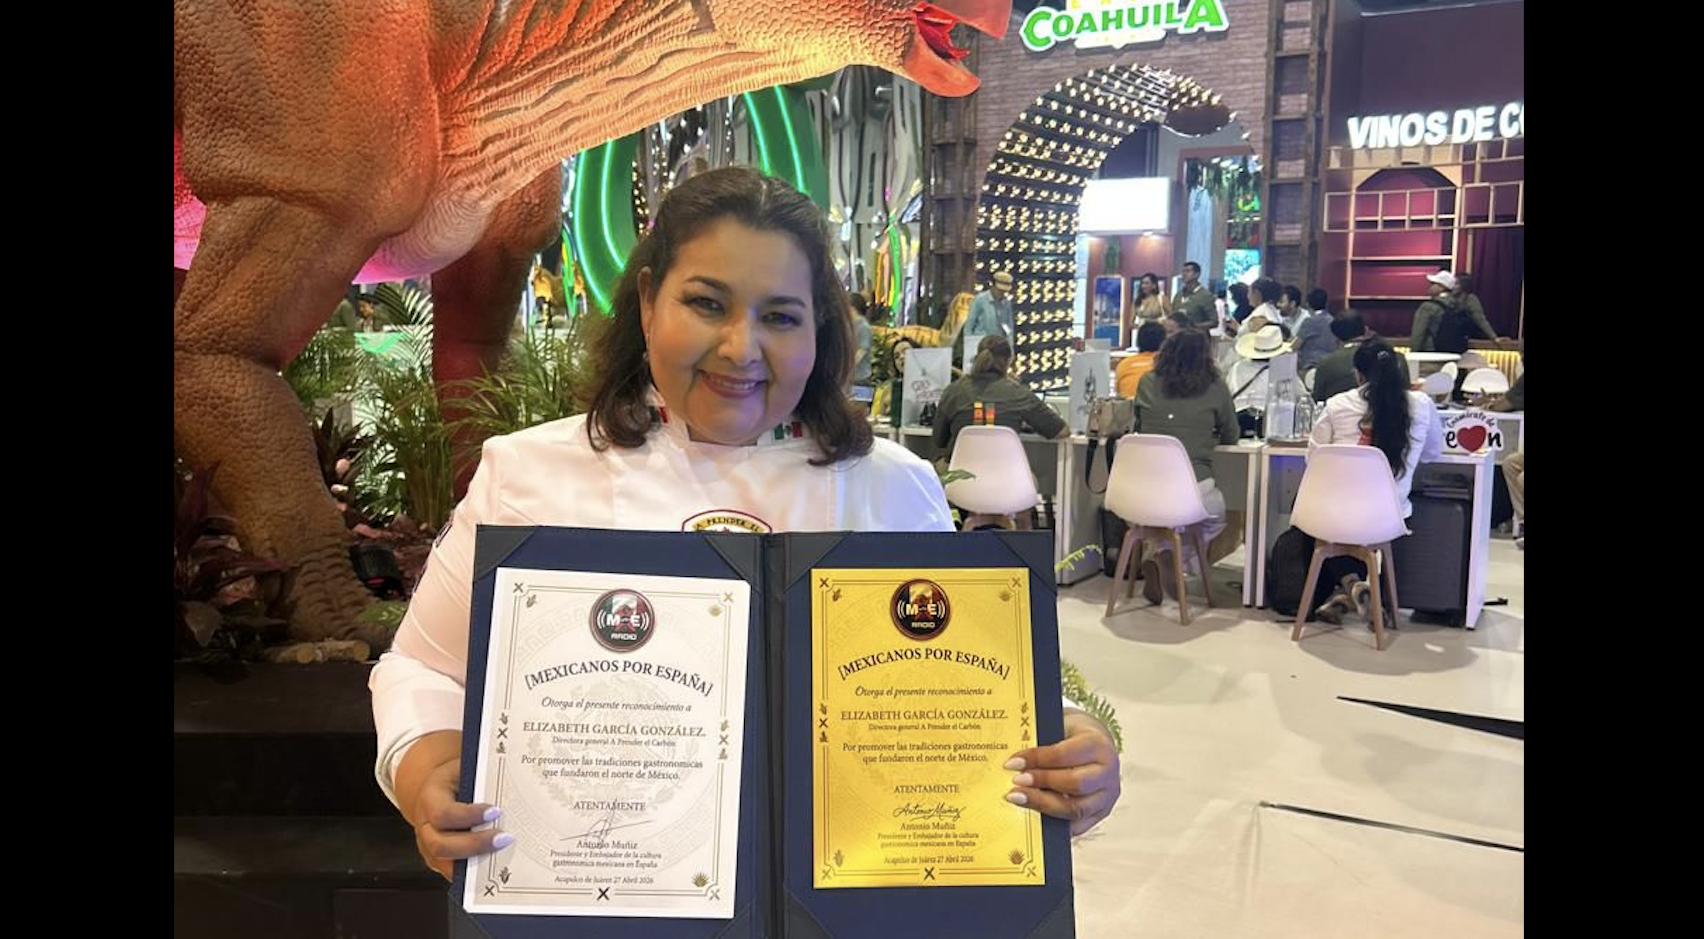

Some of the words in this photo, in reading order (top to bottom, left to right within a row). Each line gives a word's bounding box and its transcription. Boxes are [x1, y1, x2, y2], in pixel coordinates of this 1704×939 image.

[1023, 0, 1224, 47] COAHUILA
[1347, 111, 1448, 149] VINOS
[1452, 106, 1497, 143] DE
[1500, 102, 1524, 138] C
[924, 649, 952, 662] POR
[622, 660, 652, 675] POR
[855, 686, 884, 698] Otorga
[886, 687, 894, 695] el
[894, 688, 926, 698] presente
[927, 687, 985, 695] reconocimiento
[541, 696, 573, 710] Otorga
[575, 698, 584, 708] el
[584, 700, 619, 711] presente
[621, 702, 683, 711] reconocimiento
[841, 711, 901, 720] ELIZABETH
[903, 708, 944, 720] GARCÍA
[523, 722, 589, 733] ELIZABETH
[592, 723, 637, 735] GARCÍA
[843, 743, 856, 751] Por
[858, 744, 895, 753] promover
[897, 742, 907, 751] las
[909, 742, 951, 751] tradiciones
[521, 755, 536, 764] Por
[538, 756, 579, 766] promover
[582, 756, 593, 765] las
[595, 757, 641, 767] tradiciones
[862, 755, 877, 764] que
[879, 754, 915, 762] fundaron
[916, 754, 923, 762] el
[947, 754, 957, 762] de
[542, 769, 558, 779] que
[560, 768, 599, 777] fundaron
[601, 769, 609, 778] el
[611, 770, 633, 779] norte
[635, 770, 645, 779] de
[894, 785, 961, 794] ATENTAMENTE
[574, 801, 646, 811] ATENTAMENTE
[900, 822, 930, 831] Antonio
[576, 840, 610, 849] Antonio
